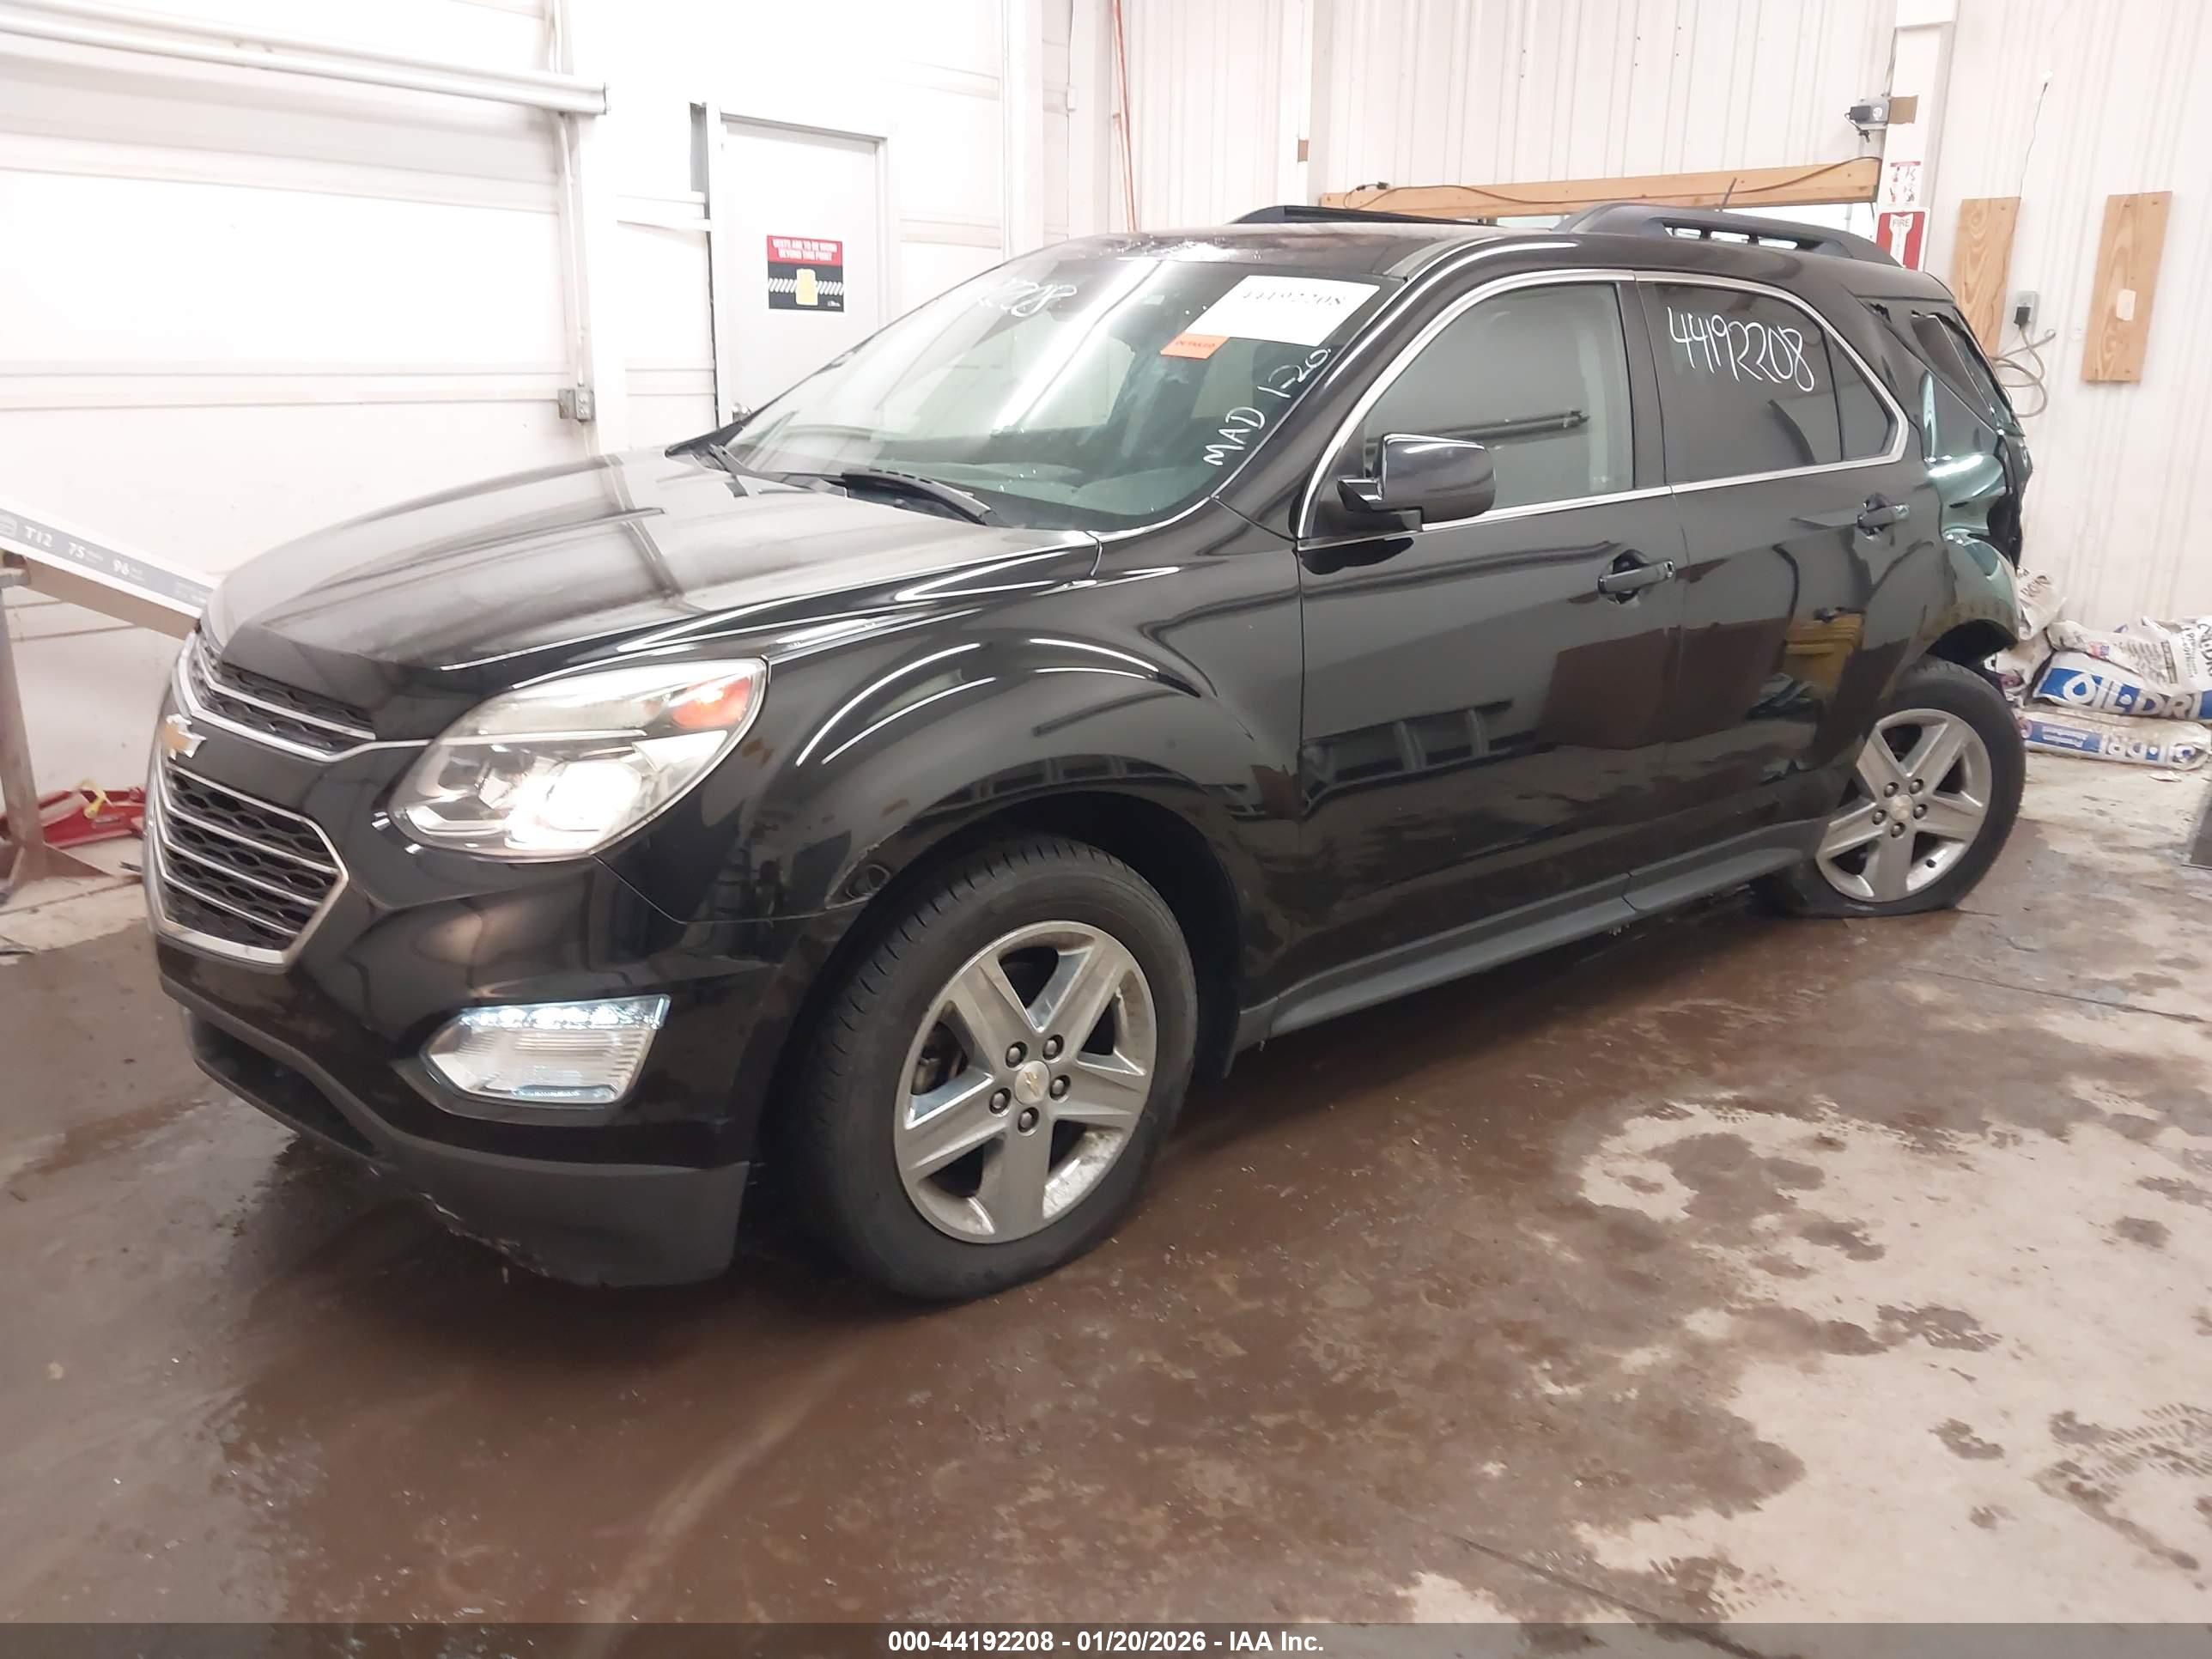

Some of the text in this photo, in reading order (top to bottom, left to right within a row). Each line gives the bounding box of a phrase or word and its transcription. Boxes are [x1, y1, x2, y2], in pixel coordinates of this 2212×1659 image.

[1893, 218, 1911, 228] FIRE
[1203, 406, 1266, 466] MAD
[24, 526, 53, 548] T12
